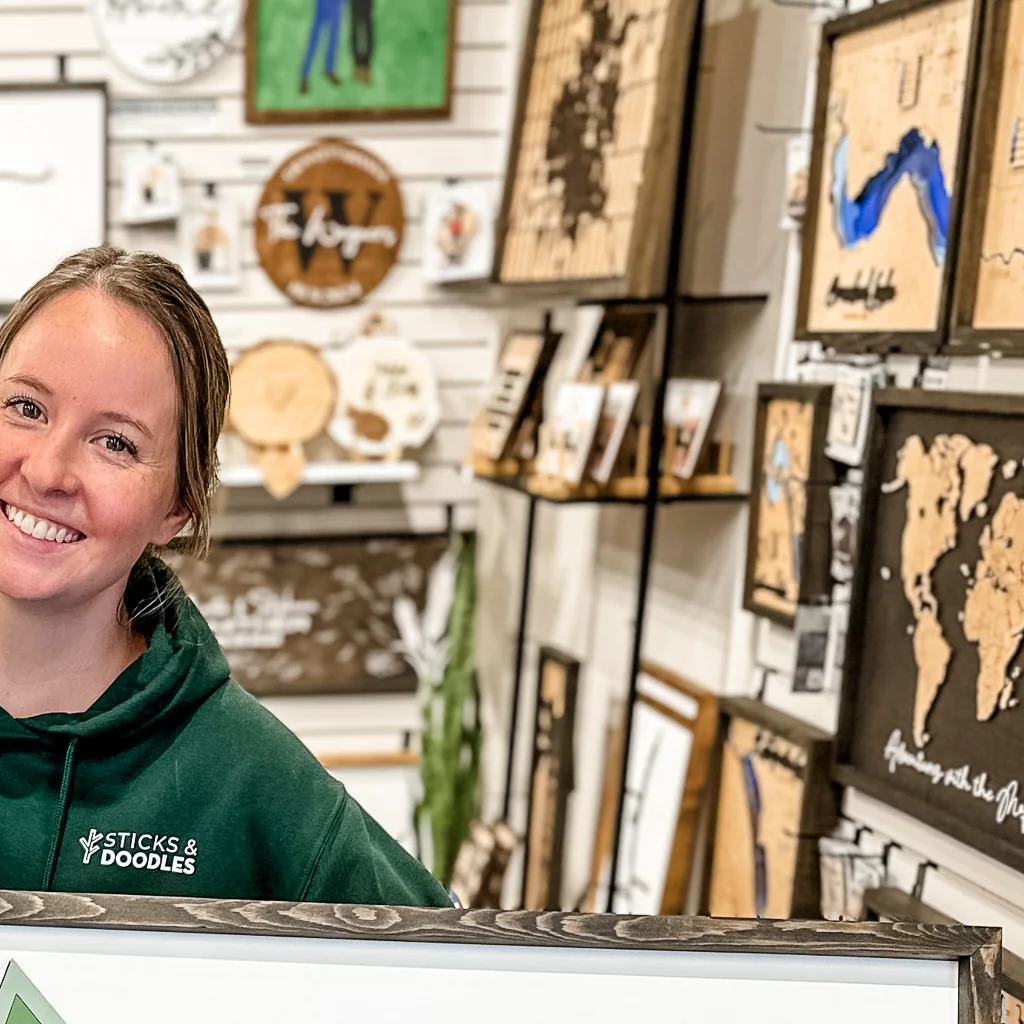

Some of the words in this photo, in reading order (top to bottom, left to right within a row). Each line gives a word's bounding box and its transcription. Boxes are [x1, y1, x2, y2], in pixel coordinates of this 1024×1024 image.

[971, 771, 995, 803] the
[103, 831, 180, 853] STICKS
[183, 838, 198, 856] &
[100, 848, 196, 875] DOODLES
